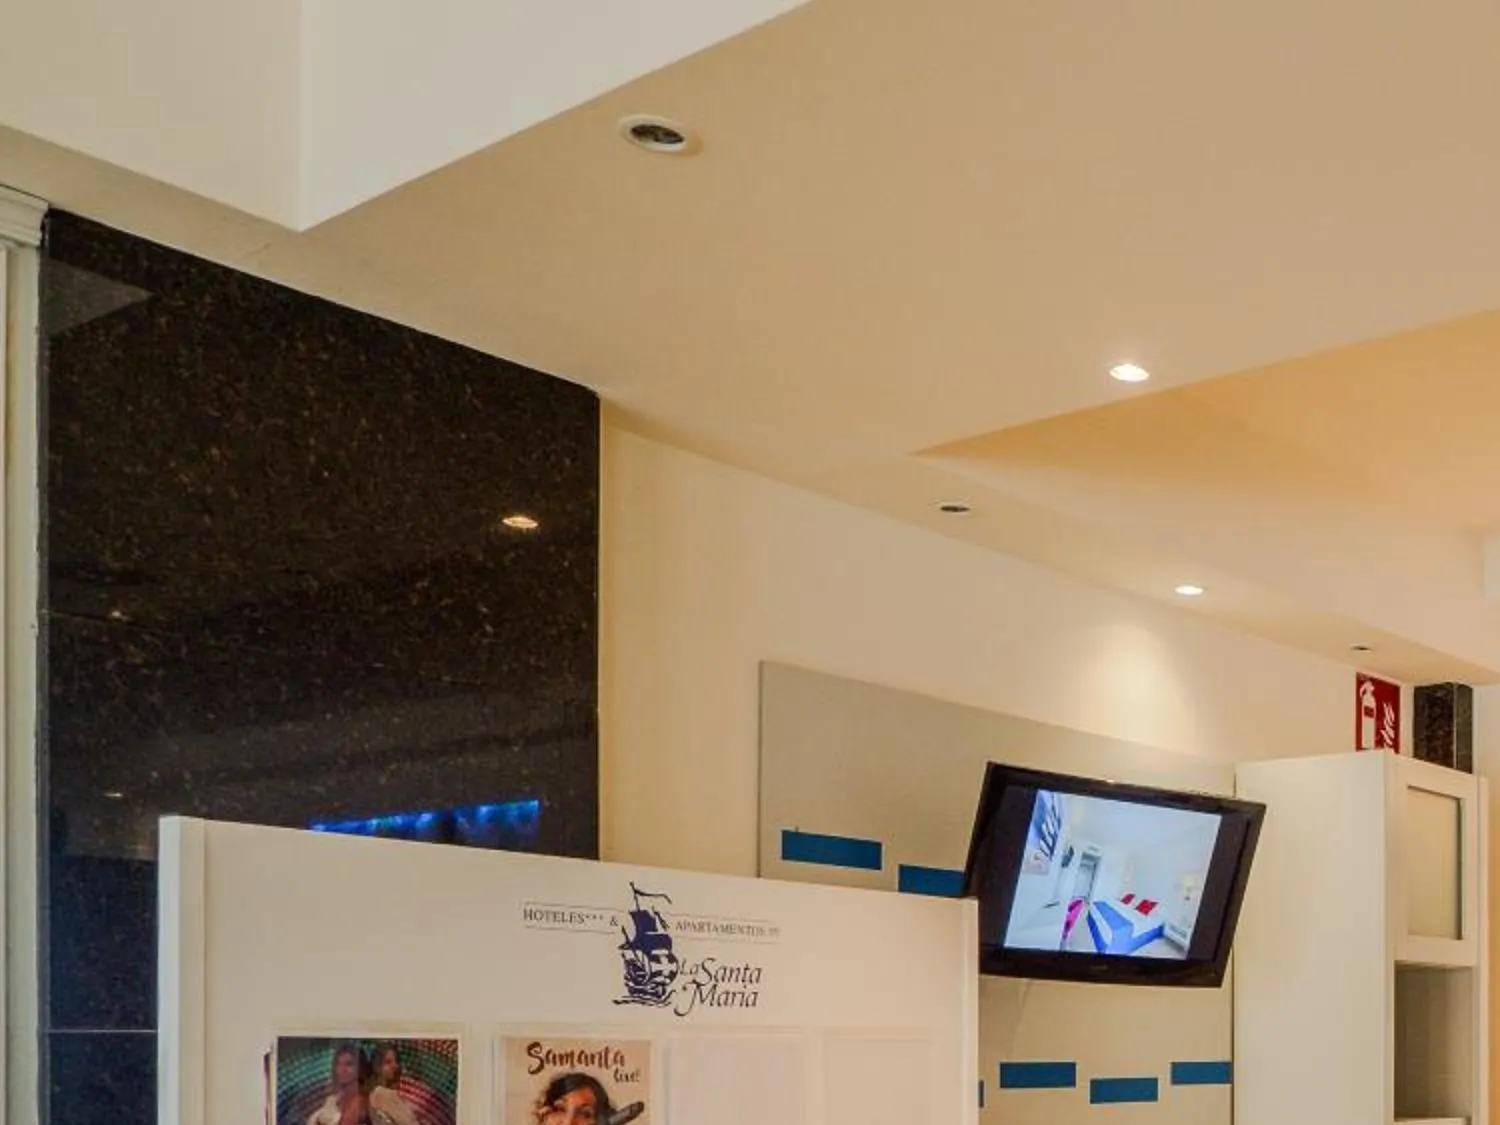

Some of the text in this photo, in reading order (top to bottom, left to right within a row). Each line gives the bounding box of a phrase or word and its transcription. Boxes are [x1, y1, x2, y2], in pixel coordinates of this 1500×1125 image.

[680, 957, 762, 986] La Santa
[526, 1041, 625, 1075] Samanta
